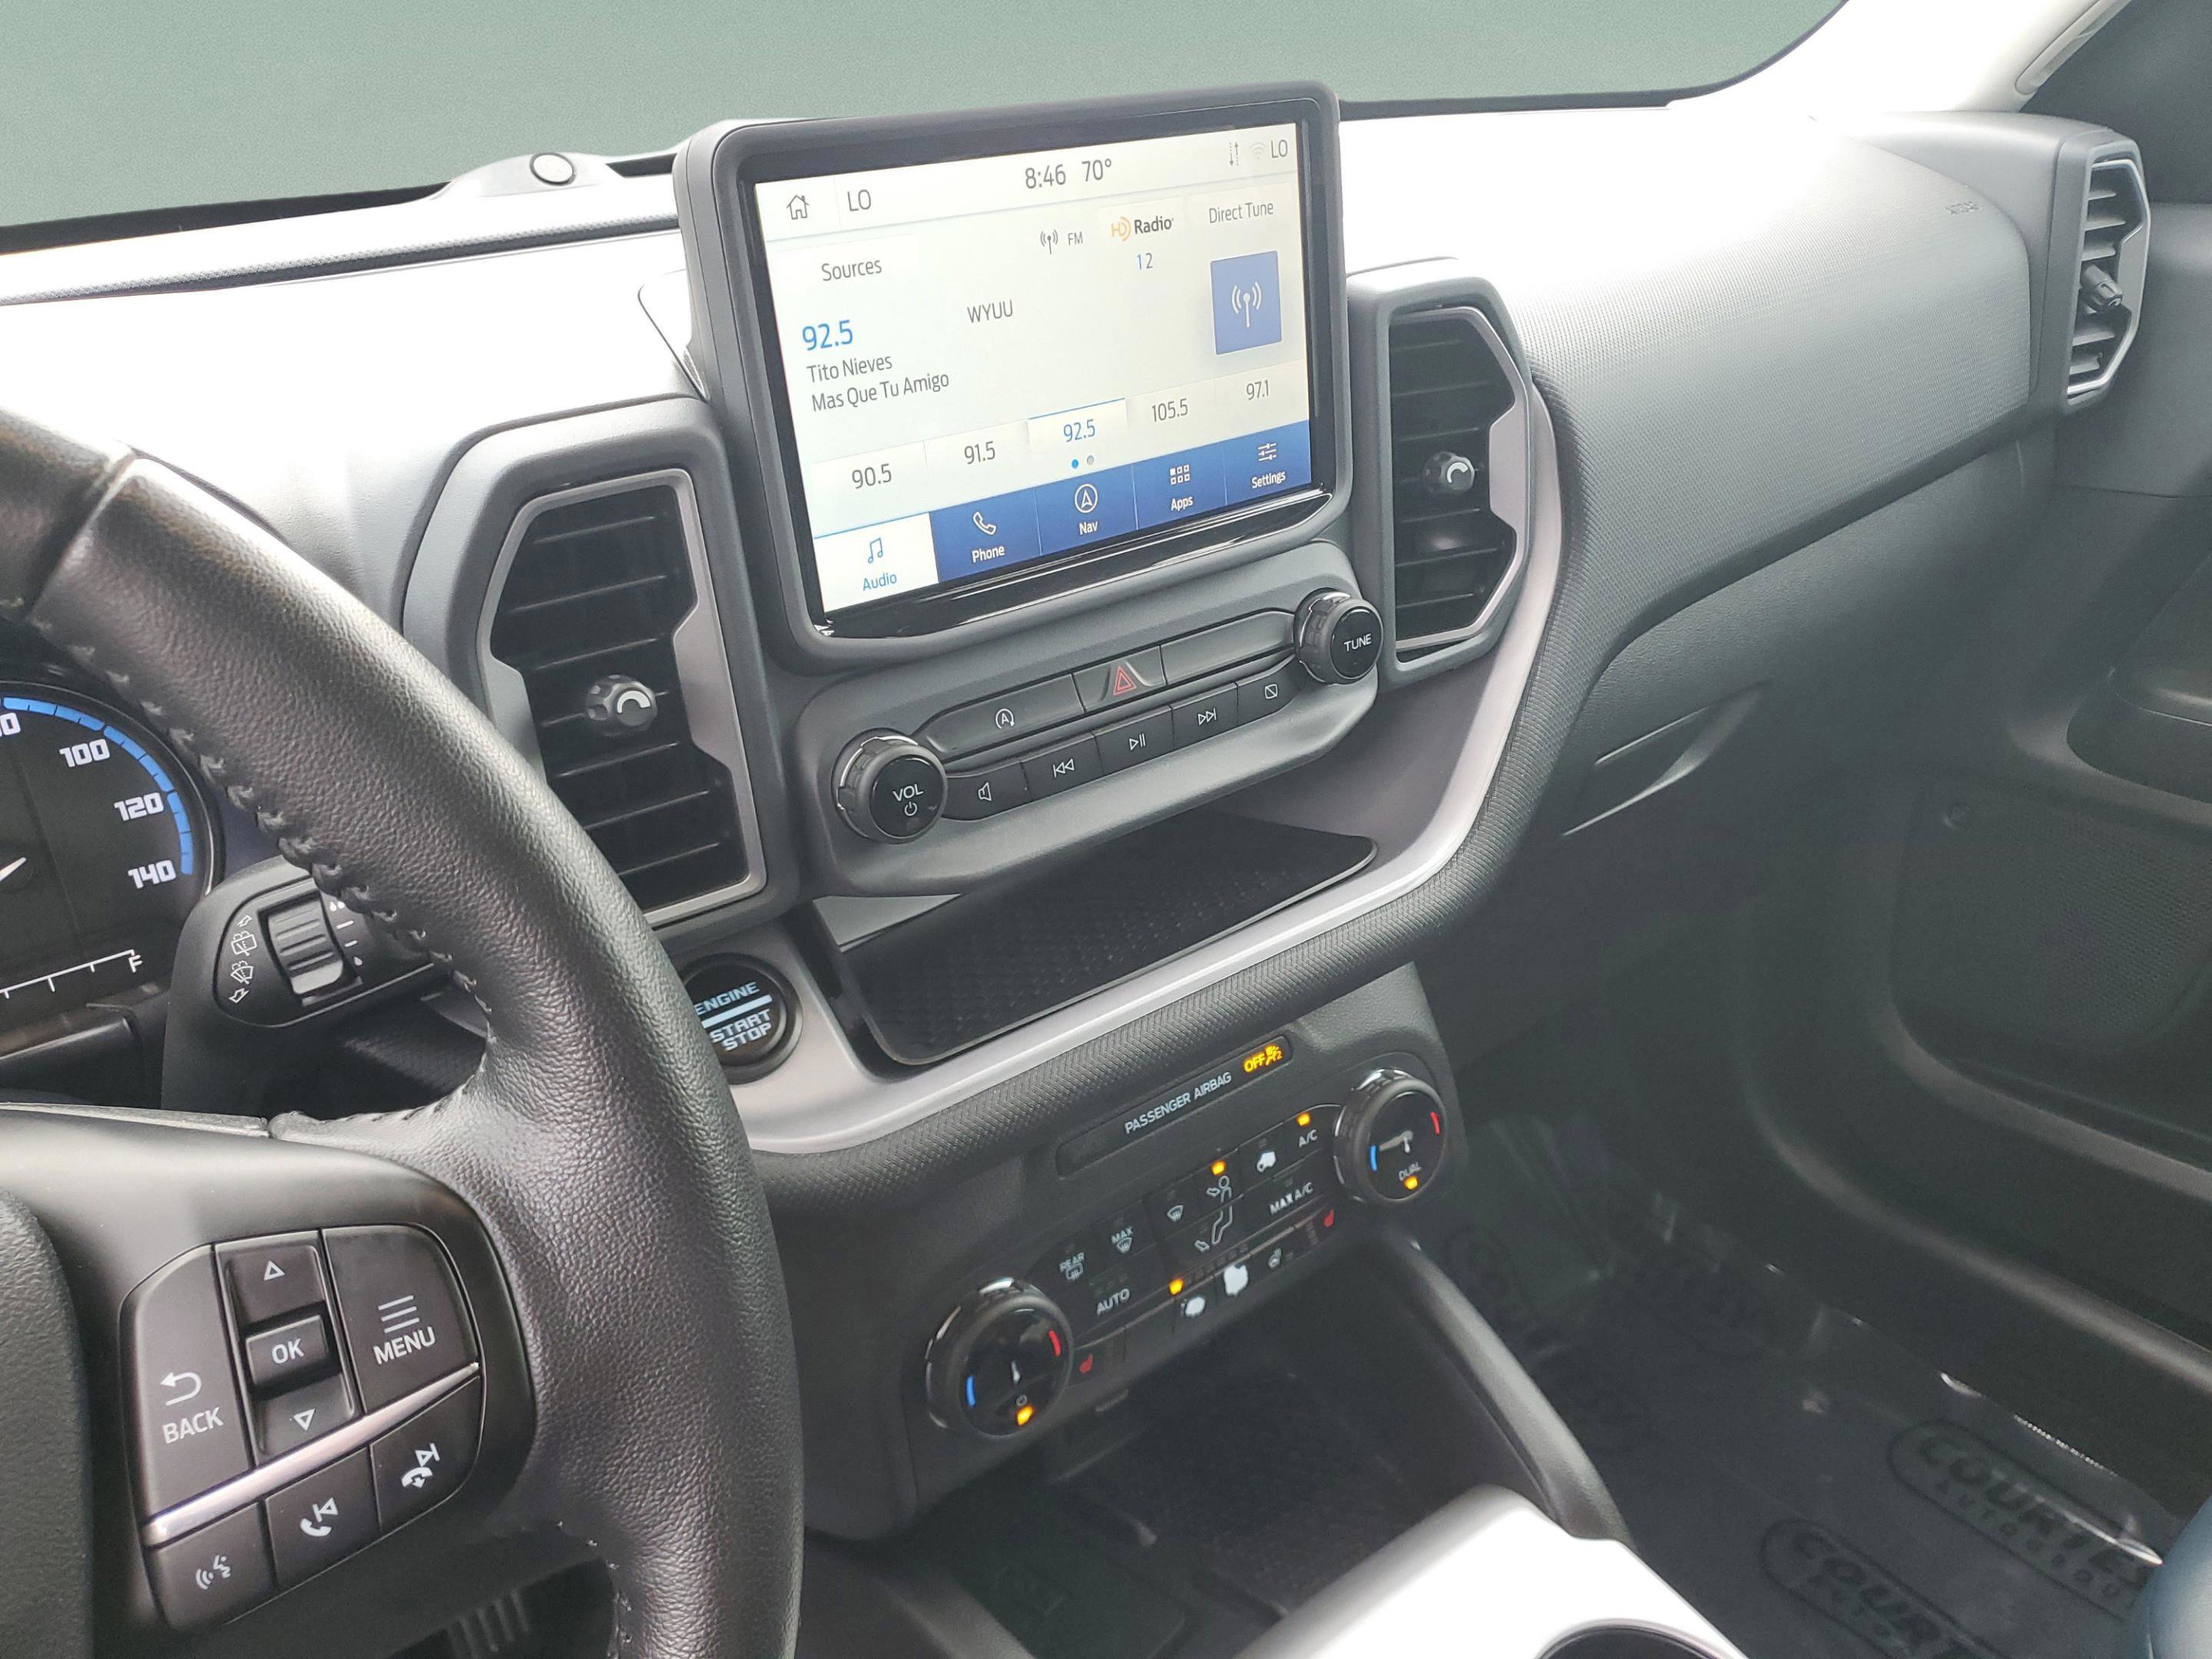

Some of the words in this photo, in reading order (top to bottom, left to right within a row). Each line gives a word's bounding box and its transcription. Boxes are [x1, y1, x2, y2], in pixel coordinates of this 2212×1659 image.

[1270, 139, 1288, 158] LO
[1025, 164, 1066, 189] 8:46
[1081, 158, 1112, 182] 70°
[847, 189, 872, 212] LO
[1208, 204, 1243, 224] Direct
[1245, 200, 1274, 218] Tune
[1134, 216, 1172, 235] Radio
[1068, 231, 1084, 246] FM
[821, 259, 882, 281] Sources
[967, 300, 1014, 323] WYUU
[802, 320, 853, 351] 92.5
[806, 364, 839, 383] Tito
[843, 356, 892, 377] Nieves
[812, 392, 844, 412] Mas
[846, 386, 877, 407] Que
[880, 380, 899, 399] Tu
[903, 373, 949, 395] Amigo
[1246, 379, 1270, 400] 97.1
[1151, 398, 1188, 422] 105.5
[1063, 419, 1095, 442] 92.5
[964, 441, 995, 465] 91.5
[851, 463, 892, 488] 90.5
[1251, 469, 1286, 489] Settings
[1171, 495, 1193, 512] Apps
[1079, 520, 1098, 535] Nav
[972, 545, 1005, 563] Phone
[863, 572, 897, 591] Audio
[1343, 634, 1373, 652] TUNE
[0, 712, 22, 737] 0
[59, 738, 110, 768] 100
[892, 783, 924, 802] VOL
[114, 792, 164, 821] 120
[128, 859, 176, 889] 140
[128, 954, 143, 973] F
[694, 982, 760, 1015] ENGINE
[709, 1008, 771, 1043] START
[722, 1022, 772, 1051] STOP
[1124, 1093, 1191, 1134] PASSENGER
[1194, 1071, 1231, 1100] AIRBAG
[1244, 1052, 1266, 1073] OFF
[1299, 1129, 1318, 1148] A/C
[1270, 1193, 1293, 1215] MAX
[1295, 1182, 1313, 1200] A/C
[1111, 1226, 1133, 1244] MAX
[1059, 1252, 1084, 1271] REAR
[1096, 1288, 1130, 1317] AUTO
[271, 1338, 305, 1365] OK
[373, 1326, 436, 1365] MENU
[162, 1407, 224, 1445] BACK
